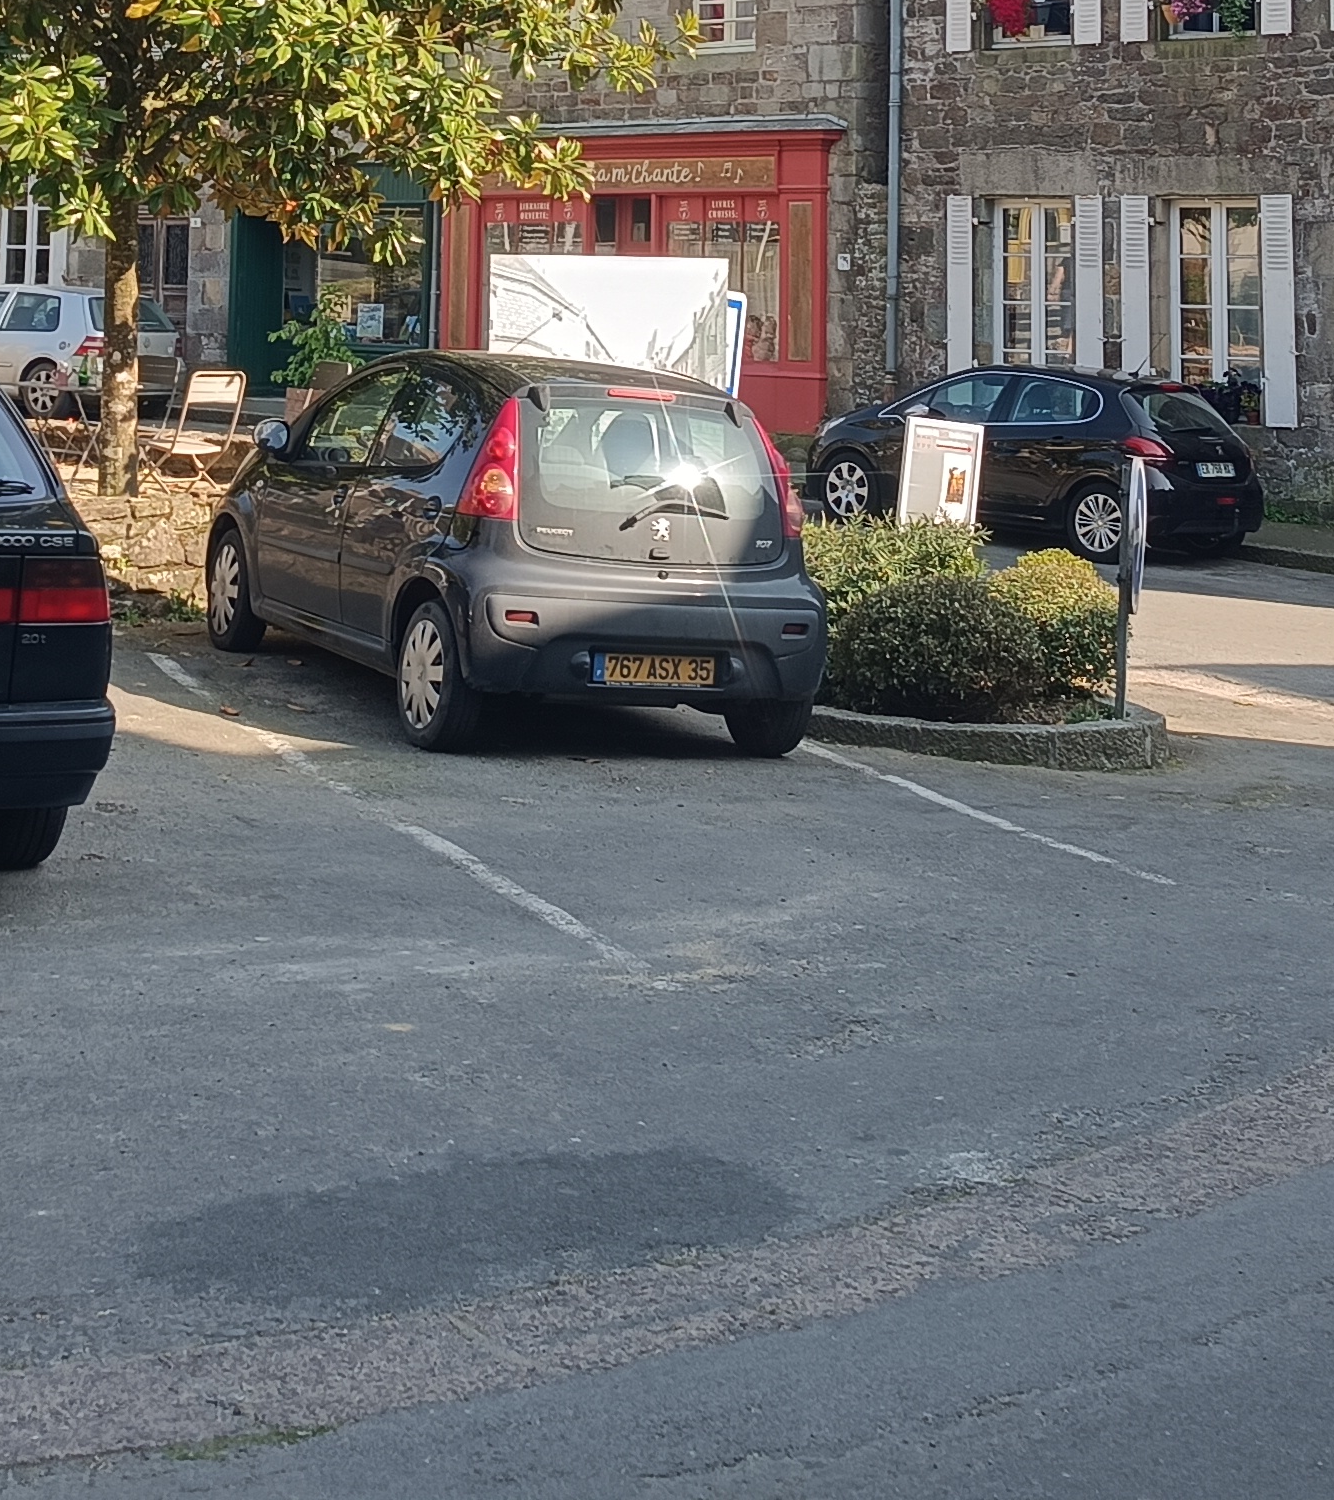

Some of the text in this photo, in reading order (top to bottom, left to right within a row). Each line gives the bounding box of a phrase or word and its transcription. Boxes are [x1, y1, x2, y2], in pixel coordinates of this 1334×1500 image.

[711, 200, 735, 209] LIVRES
[536, 526, 574, 537] PEUGEOT
[39, 536, 75, 547] CSE
[755, 539, 773, 549] 107
[608, 656, 711, 681] 767 ASX 35
